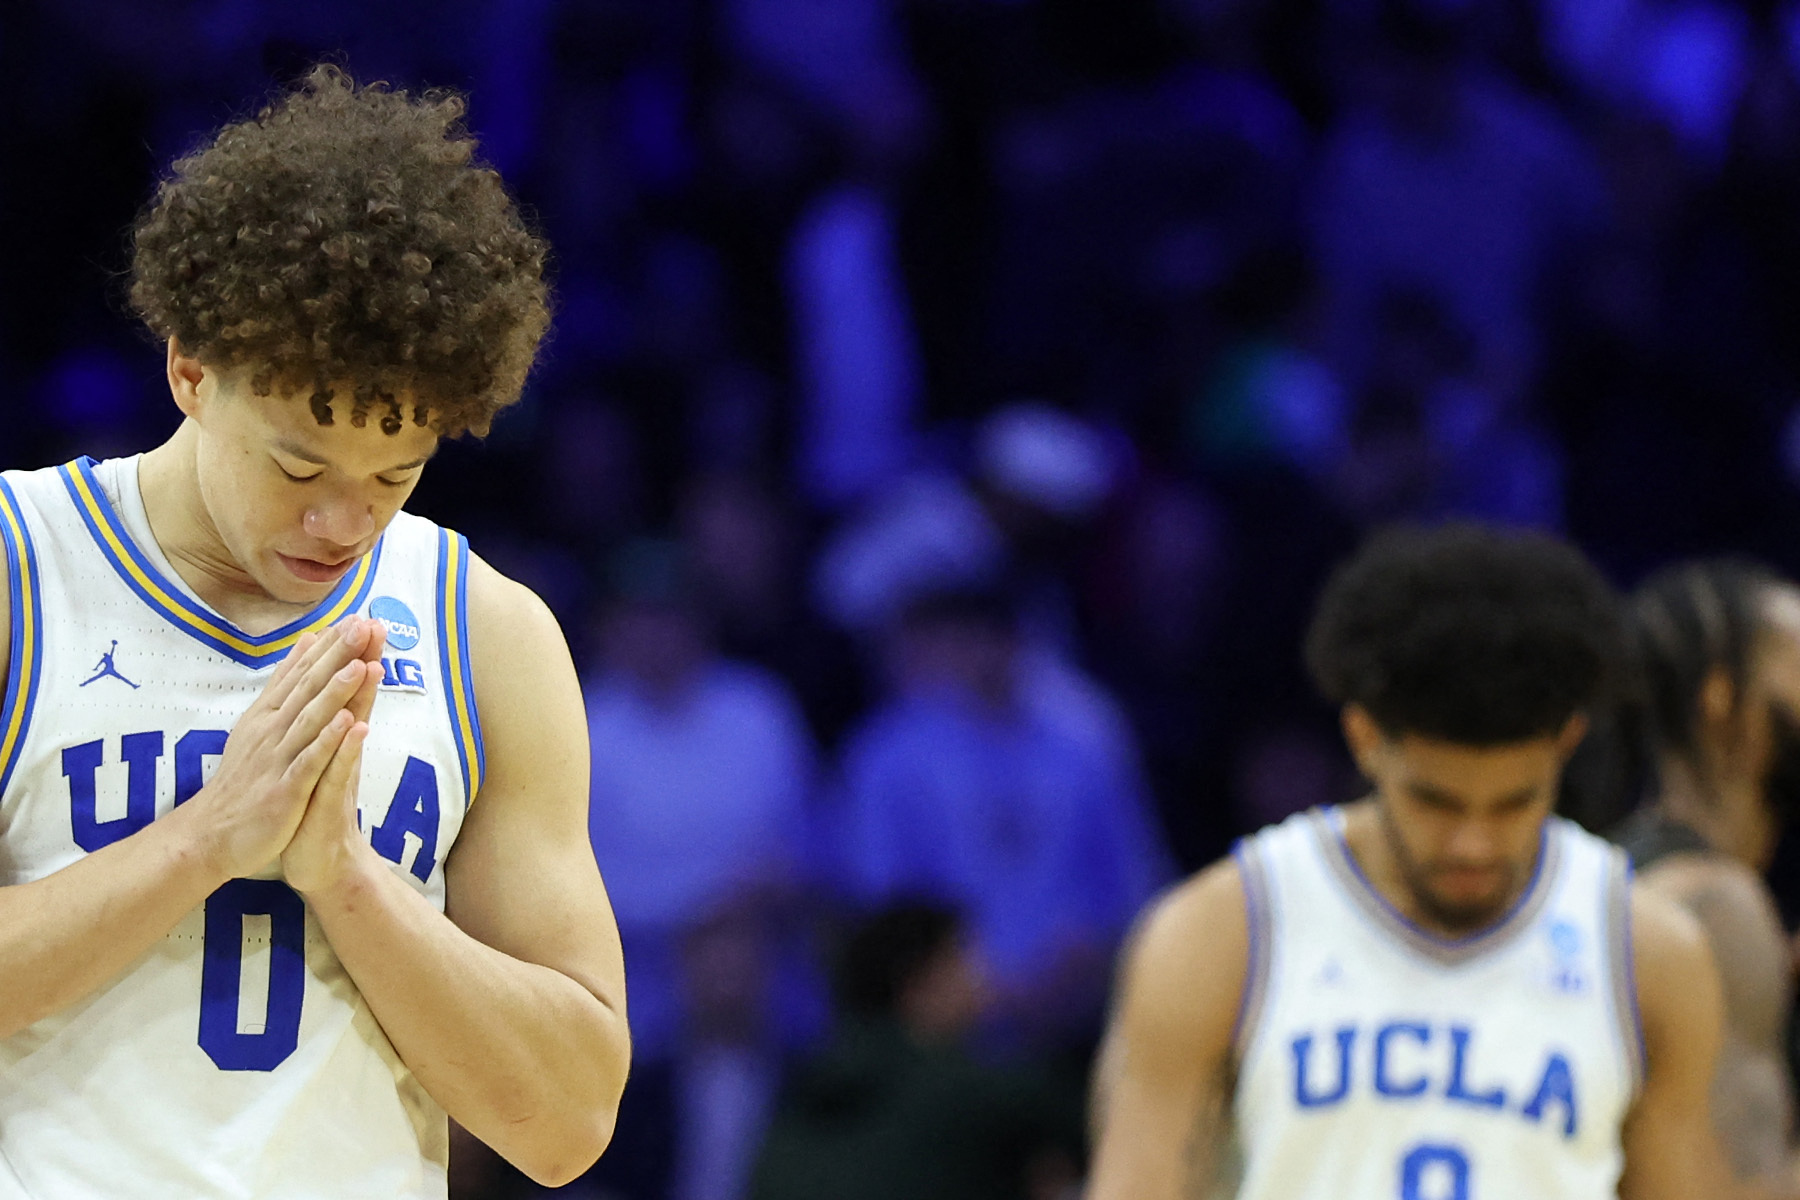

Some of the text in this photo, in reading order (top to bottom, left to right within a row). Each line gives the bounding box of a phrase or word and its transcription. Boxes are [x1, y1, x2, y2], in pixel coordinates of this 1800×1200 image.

[378, 617, 419, 640] NCAA
[61, 729, 440, 884] UA
[197, 877, 305, 1072] 0
[1290, 1022, 1578, 1136] UCLA
